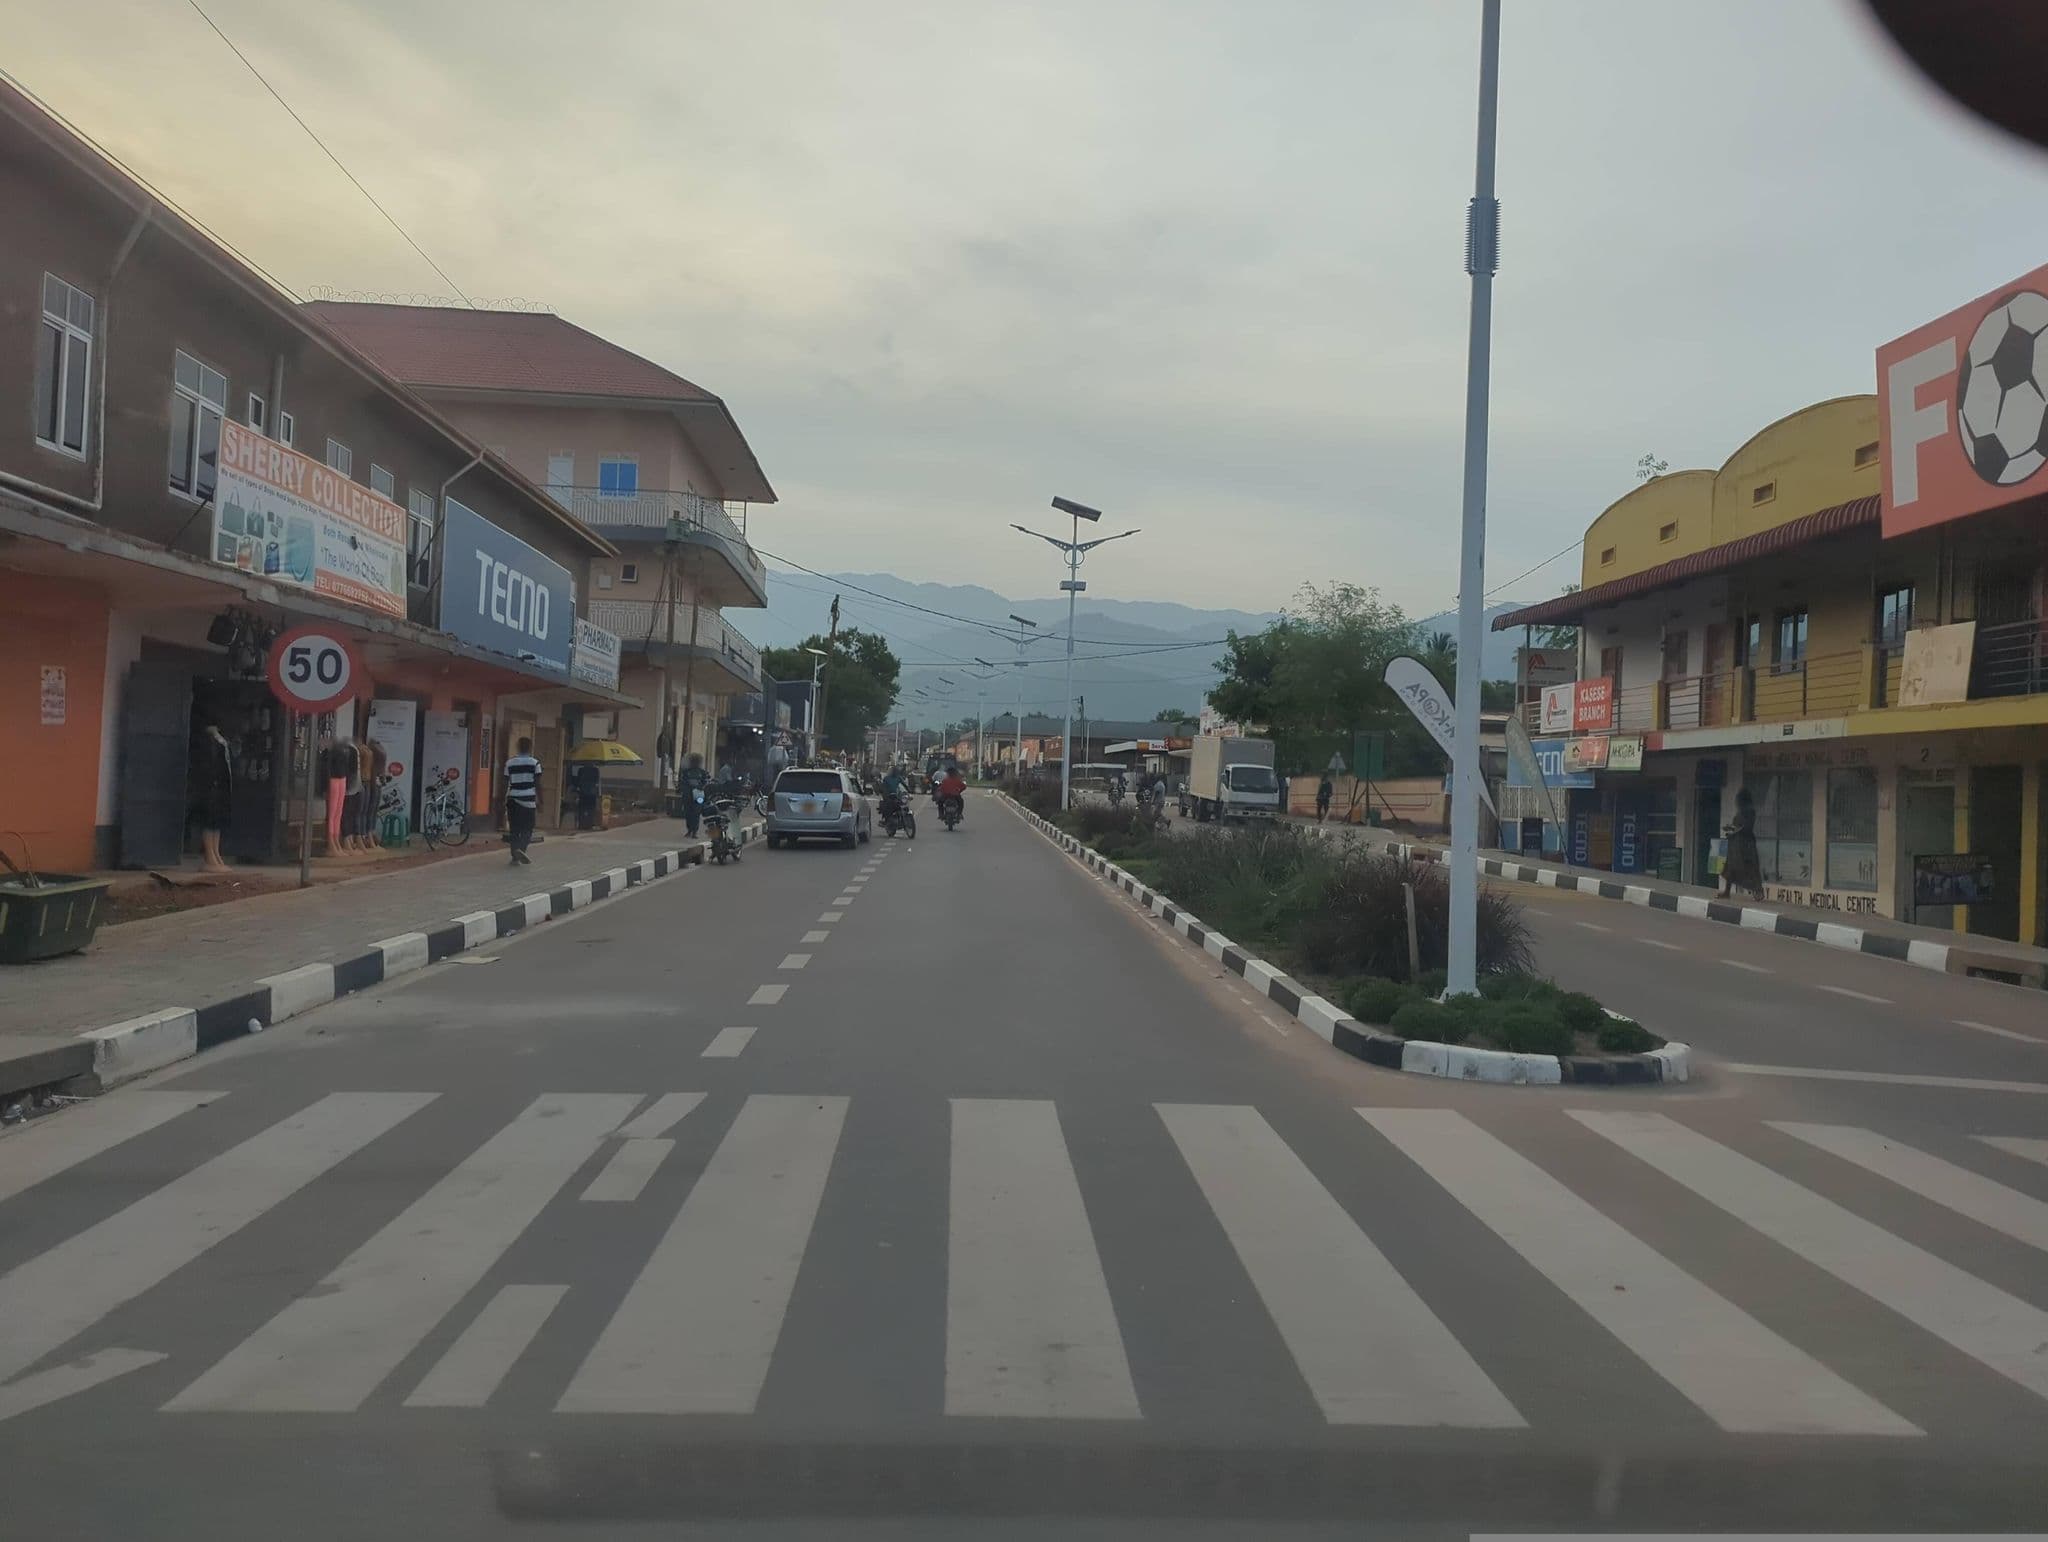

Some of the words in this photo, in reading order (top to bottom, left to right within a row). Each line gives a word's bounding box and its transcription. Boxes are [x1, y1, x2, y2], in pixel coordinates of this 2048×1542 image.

[224, 425, 306, 496] SHERRY
[311, 467, 403, 542] COLLECTION
[339, 552, 360, 575] World
[476, 549, 549, 640] TECNO
[288, 647, 343, 684] 50
[1580, 686, 1606, 702] KASESE
[1579, 706, 1606, 722] BRANCH
[1921, 748, 1929, 761] 2
[1575, 813, 1588, 862] TECNO
[1622, 811, 1637, 866] TECNO
[1777, 888, 1803, 905] HEALTH
[1809, 892, 1841, 911] MEDICAL
[1846, 895, 1877, 913] CENTRE
